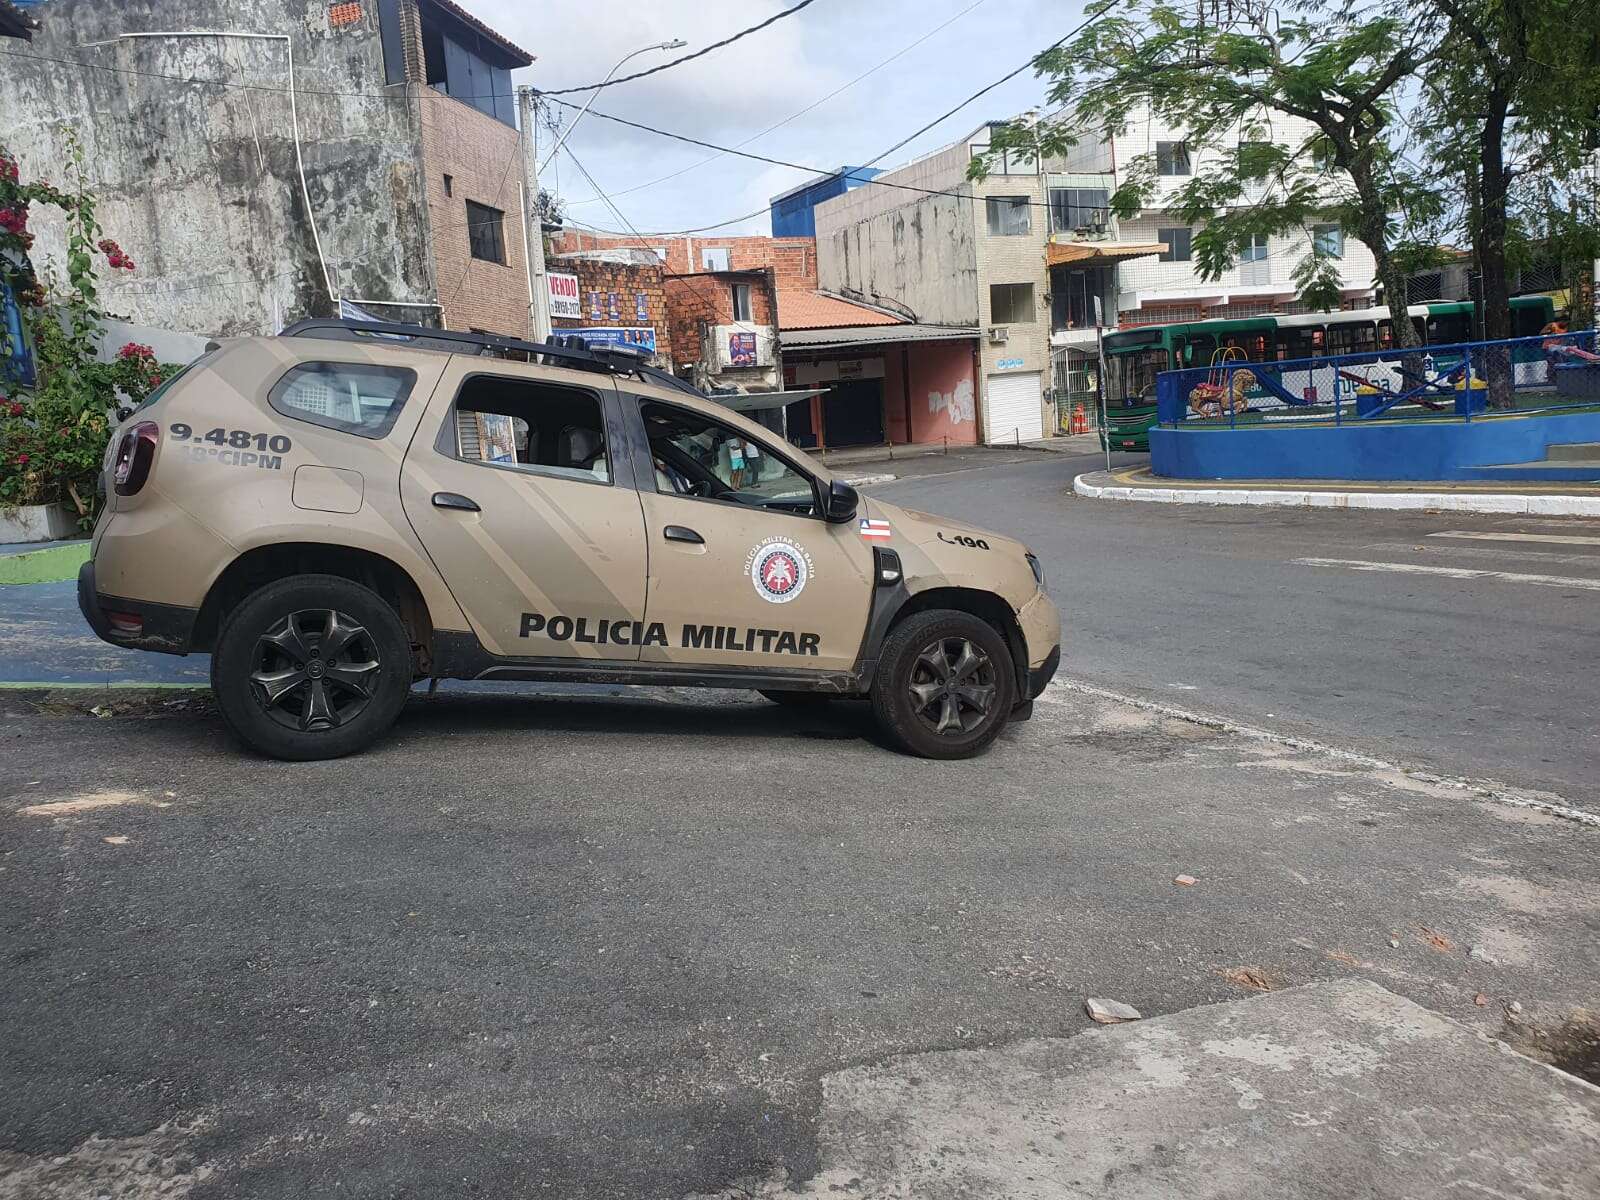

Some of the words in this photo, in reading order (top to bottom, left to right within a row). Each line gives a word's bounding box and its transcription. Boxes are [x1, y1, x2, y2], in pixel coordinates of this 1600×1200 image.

[549, 276, 577, 297] VENDO
[170, 423, 292, 454] 9.4810
[761, 535, 794, 546] MILITAR
[794, 542, 805, 553] DA
[954, 535, 990, 550] 190
[519, 612, 669, 647] POLICIA
[682, 623, 821, 657] MILITAR
